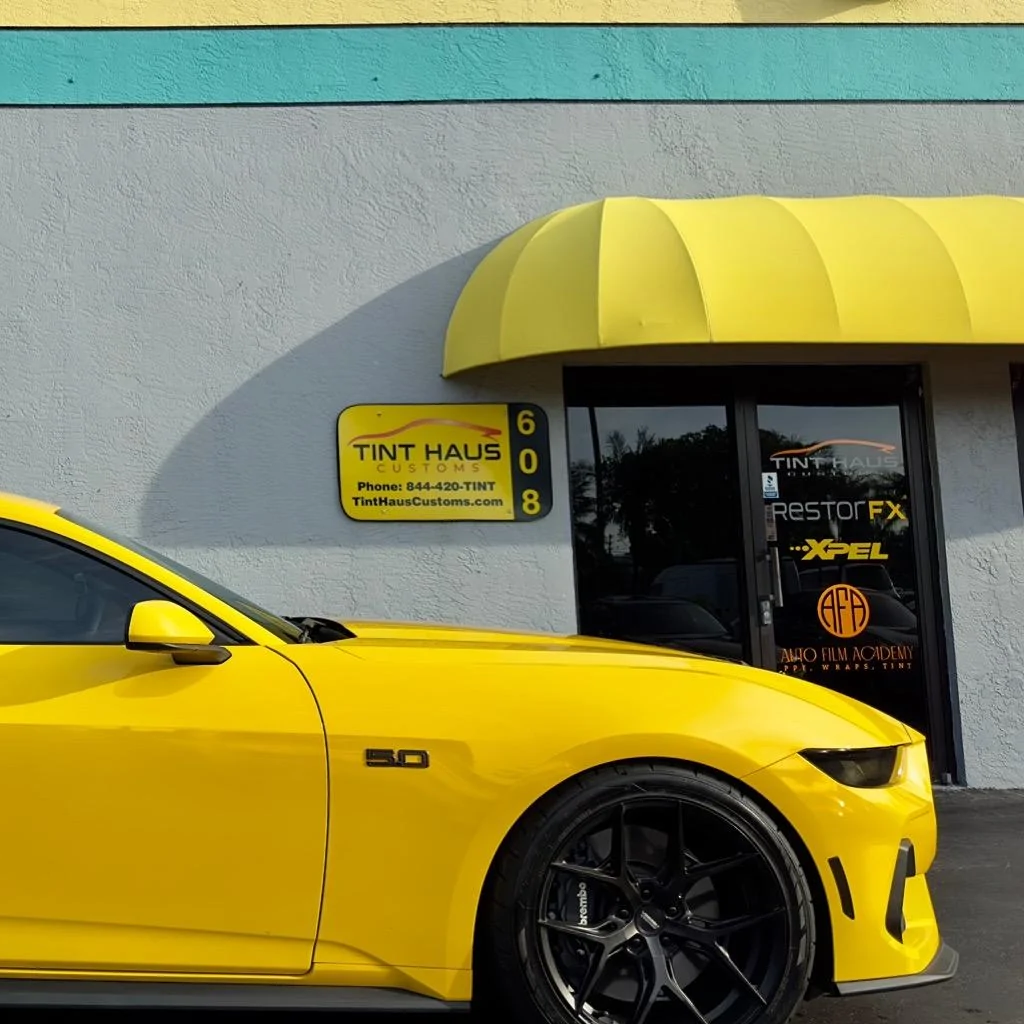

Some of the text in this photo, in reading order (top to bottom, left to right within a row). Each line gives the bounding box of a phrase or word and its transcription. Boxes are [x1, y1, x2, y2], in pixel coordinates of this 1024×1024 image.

[353, 443, 502, 461] TINT HAUS
[376, 463, 480, 474] CUSTOMS
[769, 457, 898, 469] TINT HAUS
[357, 481, 496, 492] Phone: 844-420-TINT
[352, 496, 504, 508] TintHausCustoms.com
[801, 538, 889, 561] XPEL
[820, 587, 867, 635] AFA
[780, 645, 914, 663] AUTO FILM ACADEMY
[882, 662, 913, 670] TINT
[365, 748, 430, 769] 5.0
[577, 881, 588, 926] brembo
